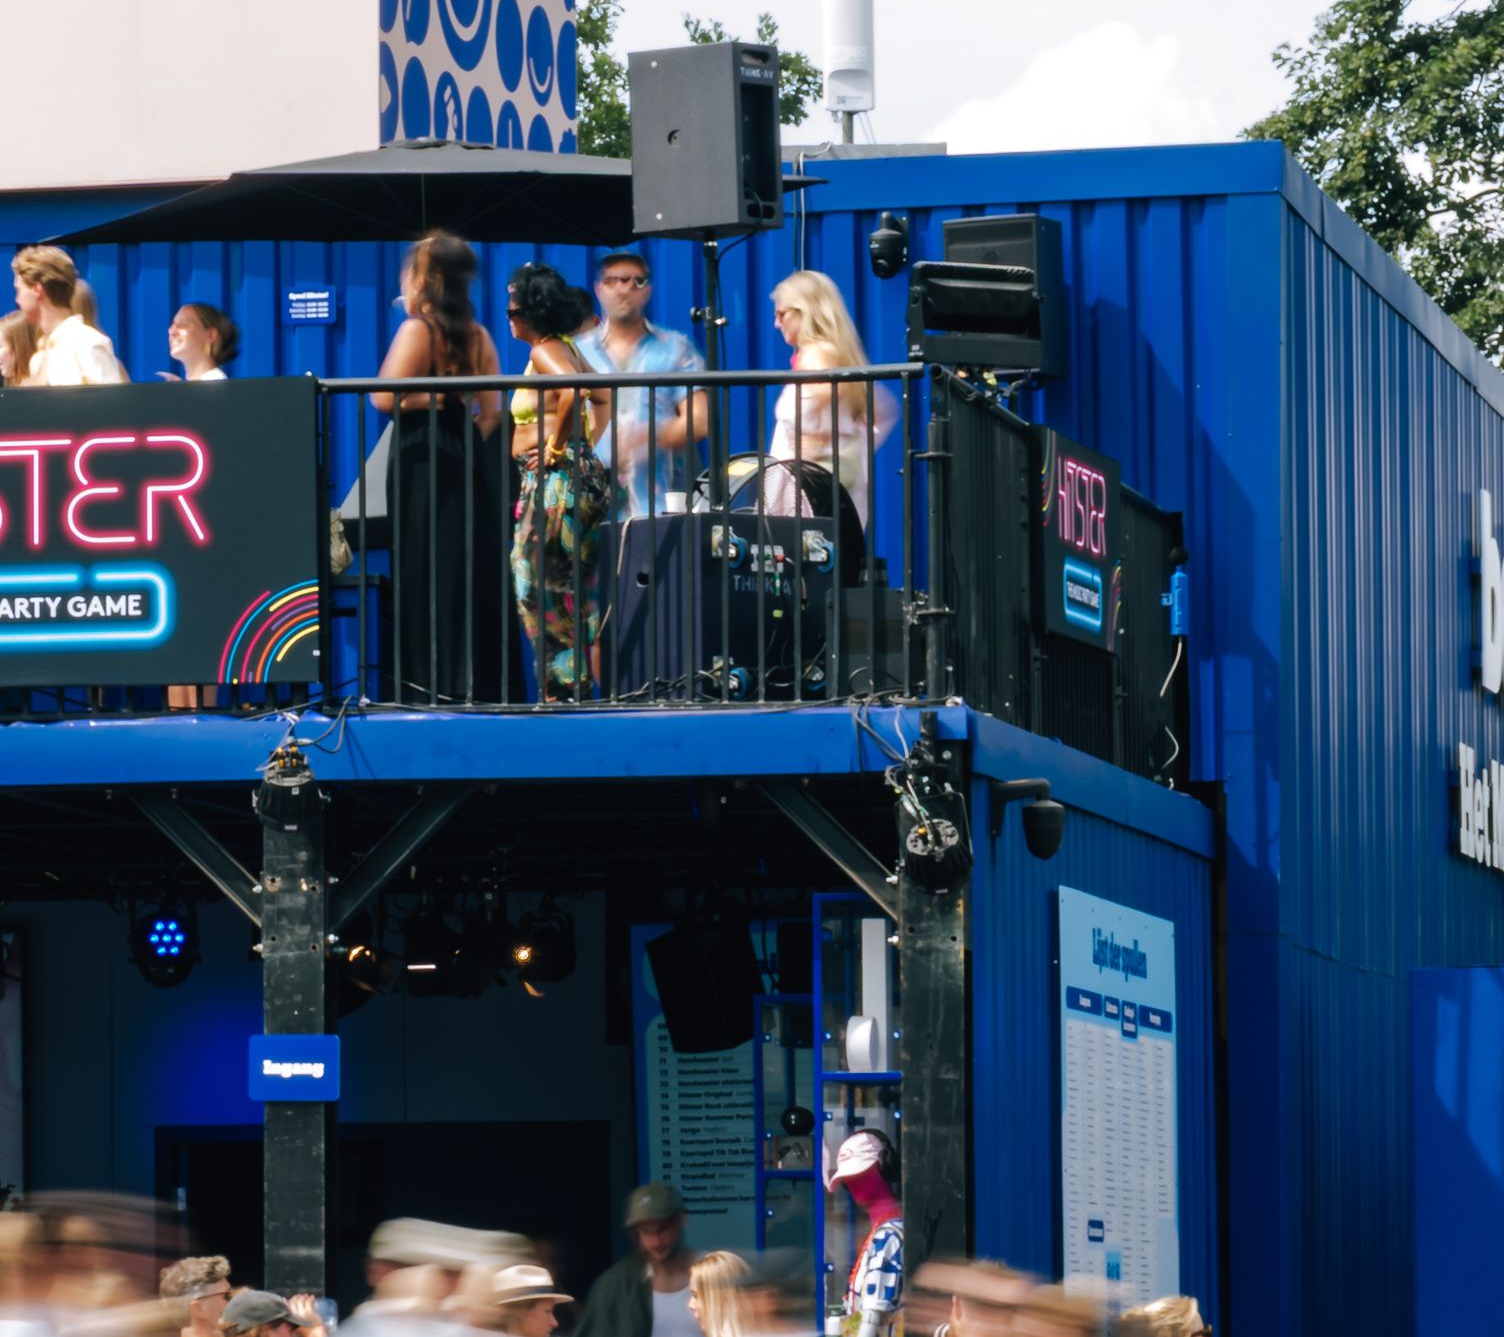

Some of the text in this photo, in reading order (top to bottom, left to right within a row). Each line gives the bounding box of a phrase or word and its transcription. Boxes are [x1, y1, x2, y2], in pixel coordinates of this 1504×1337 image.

[1058, 456, 1107, 557] HITSTER
[67, 594, 142, 617] GAME
[1458, 742, 1490, 866] Het
[263, 1059, 325, 1078] Ingang
